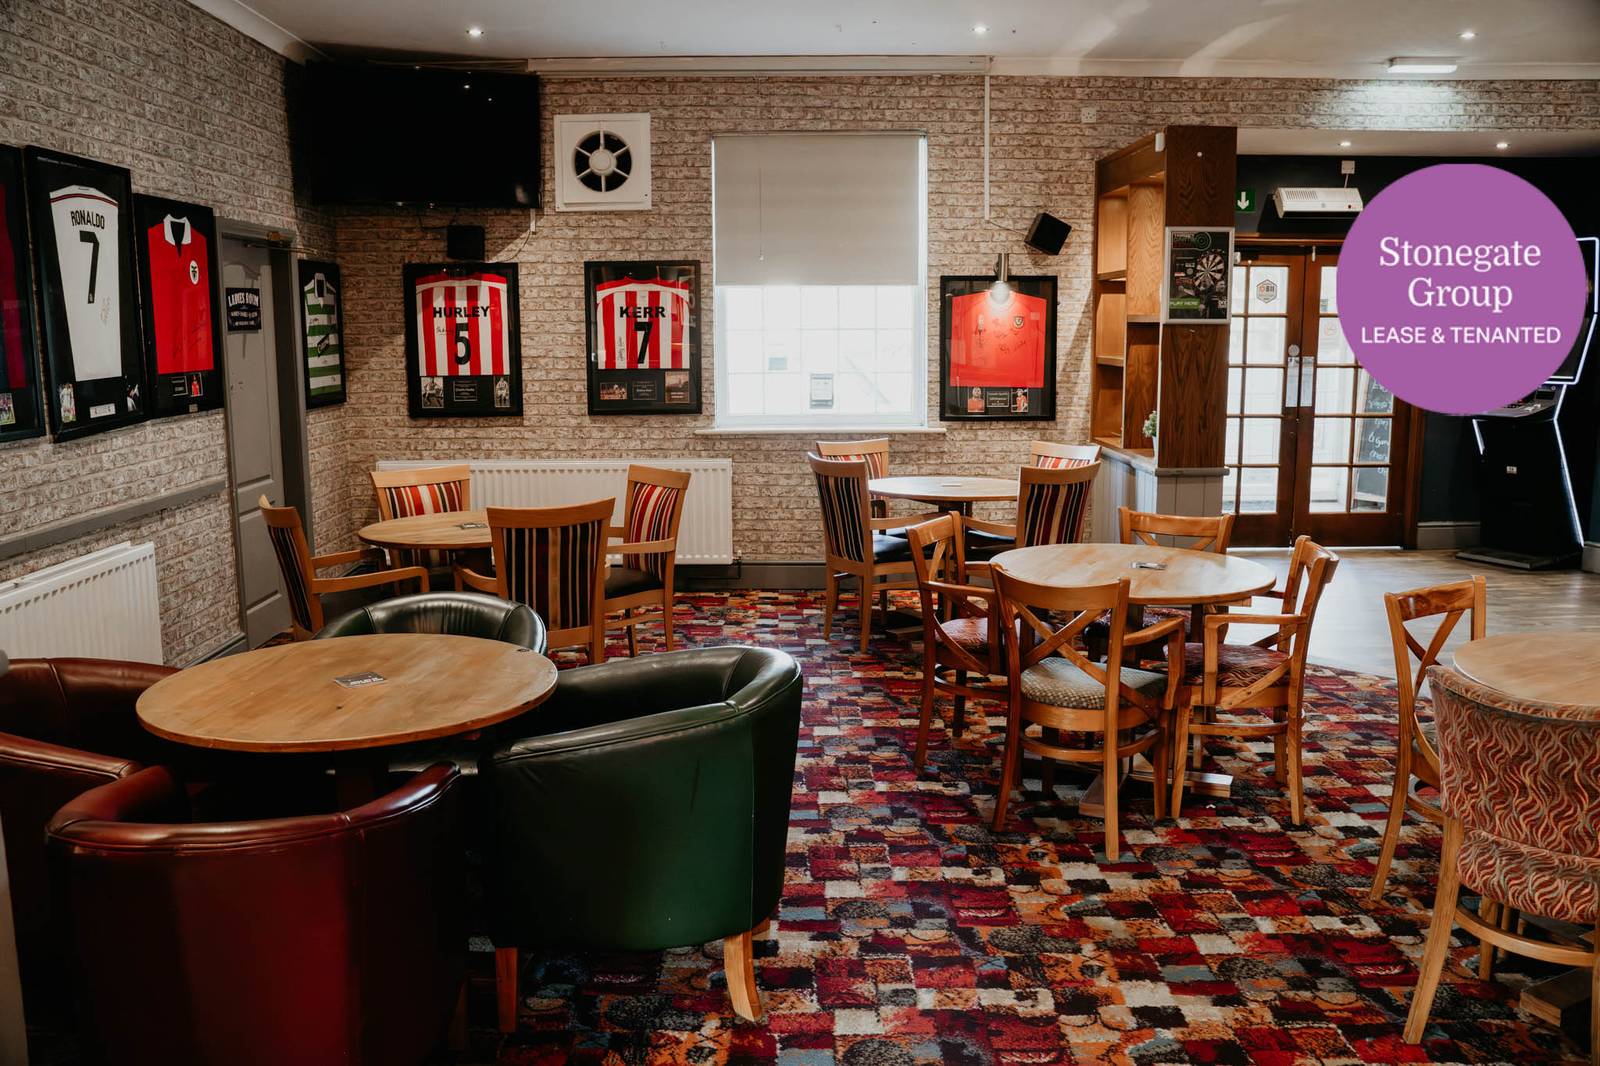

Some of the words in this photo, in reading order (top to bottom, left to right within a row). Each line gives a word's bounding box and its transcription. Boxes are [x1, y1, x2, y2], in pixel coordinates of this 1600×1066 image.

[70, 209, 105, 230] RONALDO
[79, 230, 100, 304] 7
[433, 306, 490, 319] HURLEY
[619, 306, 666, 319] KERR
[454, 323, 472, 365] 5
[633, 321, 654, 364] 7
